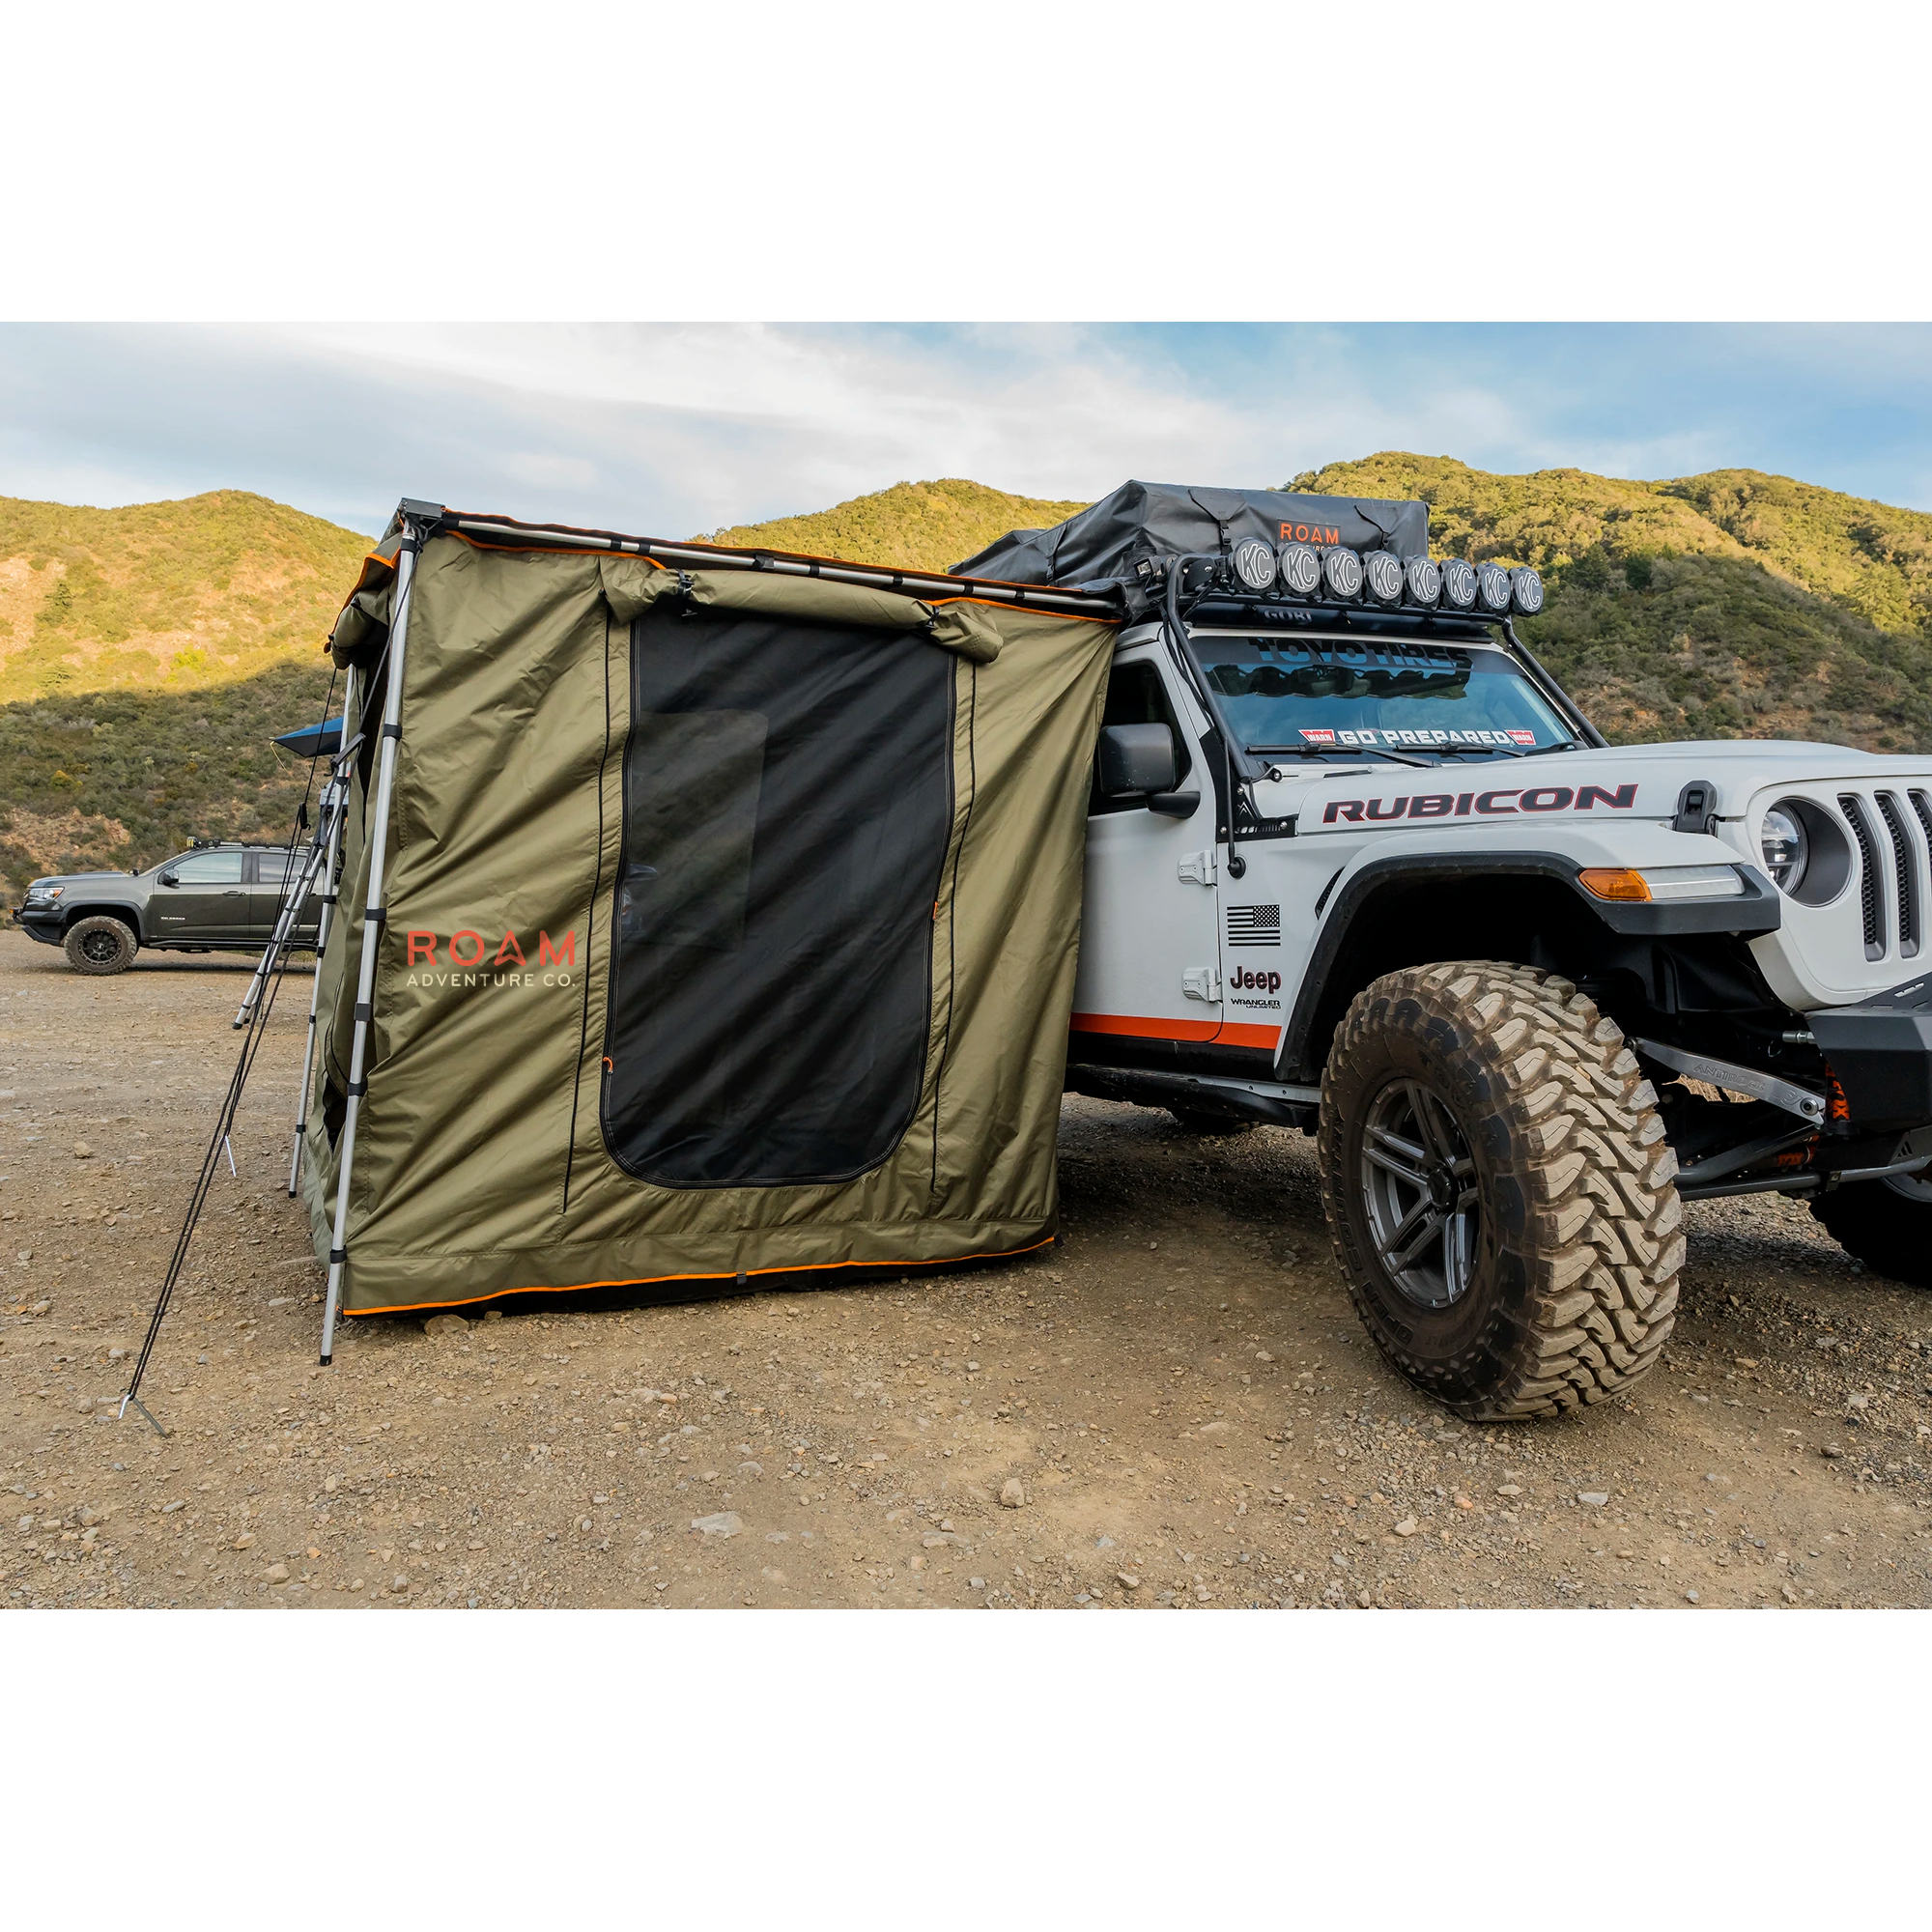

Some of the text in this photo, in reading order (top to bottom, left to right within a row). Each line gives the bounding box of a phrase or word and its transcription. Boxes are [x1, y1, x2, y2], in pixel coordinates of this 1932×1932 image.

[1280, 523, 1339, 544] ROAM
[1240, 544, 1270, 585] KC
[1288, 548, 1315, 589] KC
[1331, 553, 1358, 592] KC
[1373, 556, 1399, 596] KC
[1412, 561, 1436, 600] KC
[1450, 564, 1473, 602] KC
[1486, 569, 1507, 606] KC
[1519, 572, 1540, 609] KC
[1337, 730, 1378, 745] GO
[1380, 730, 1512, 745] PREPARED
[1322, 783, 1638, 823] RUBICON
[408, 930, 575, 966] ROAM
[407, 973, 576, 986] ADVENTURE CO.
[1230, 966, 1281, 994] Jeep
[1231, 998, 1280, 1007] WRANGLER
